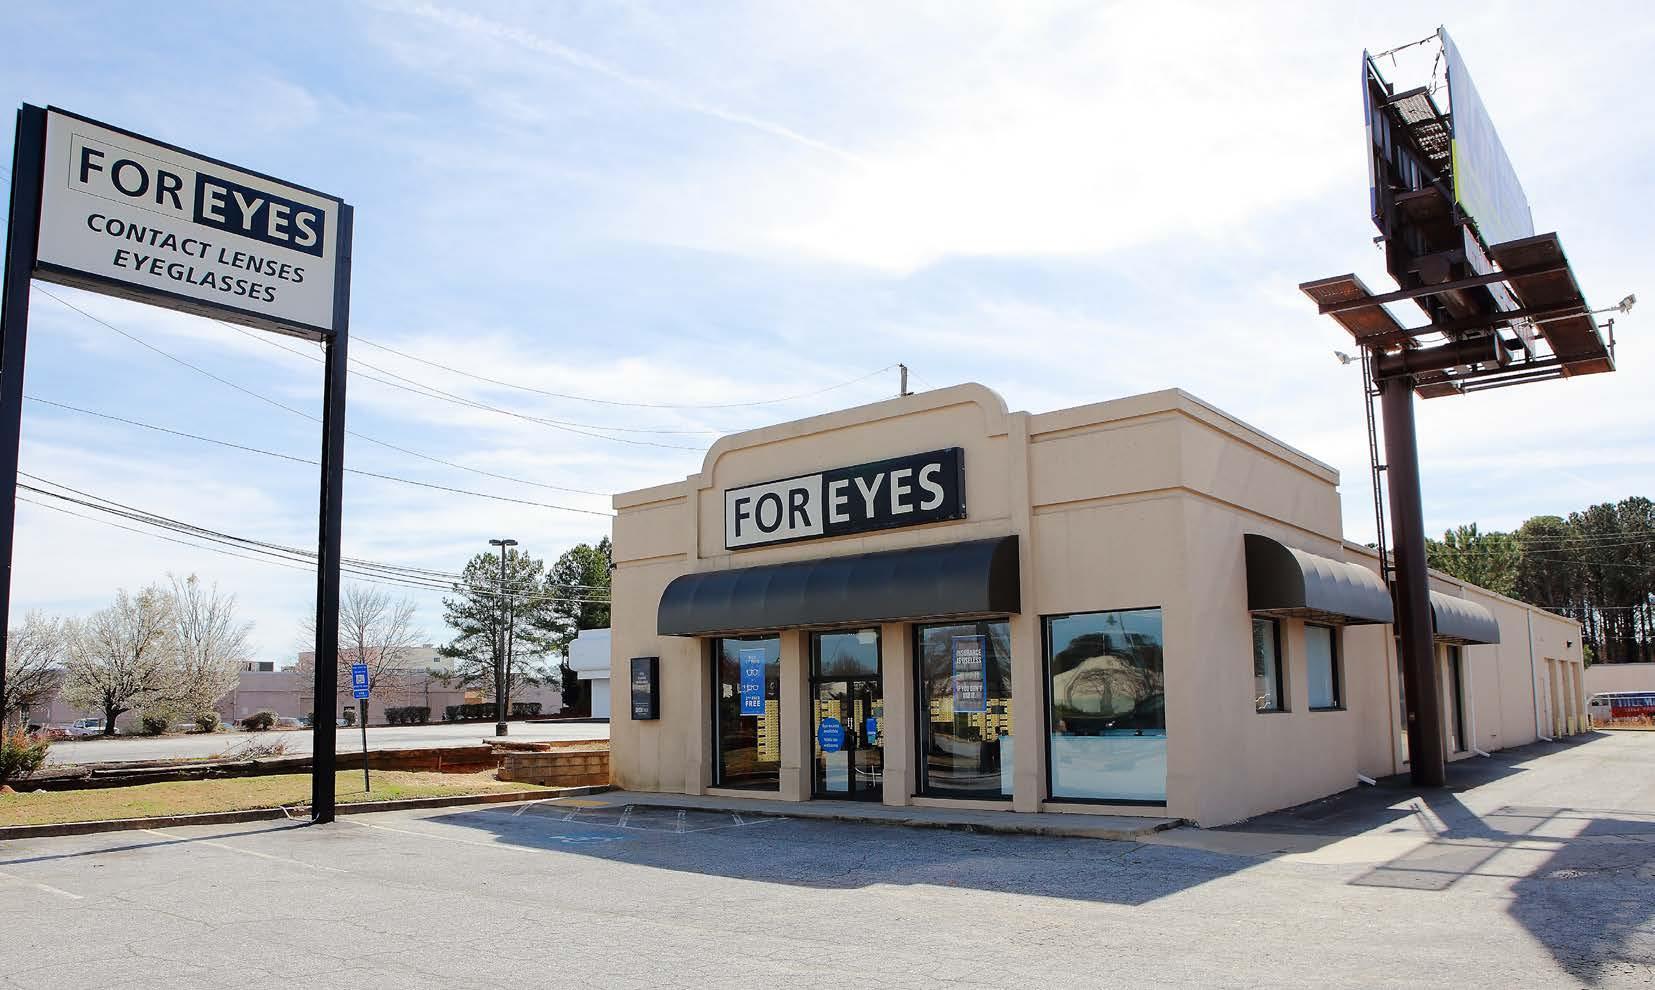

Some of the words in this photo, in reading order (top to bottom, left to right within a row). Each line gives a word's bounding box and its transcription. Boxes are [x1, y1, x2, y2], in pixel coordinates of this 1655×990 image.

[79, 146, 184, 210] FOR
[202, 182, 318, 246] EYES
[87, 213, 211, 259] CONTACT
[218, 247, 305, 283] LENSES
[113, 249, 277, 302] EYEGLASSES
[735, 487, 812, 537] FOR
[828, 463, 945, 524] EYES
[962, 656, 981, 664] USELESS
